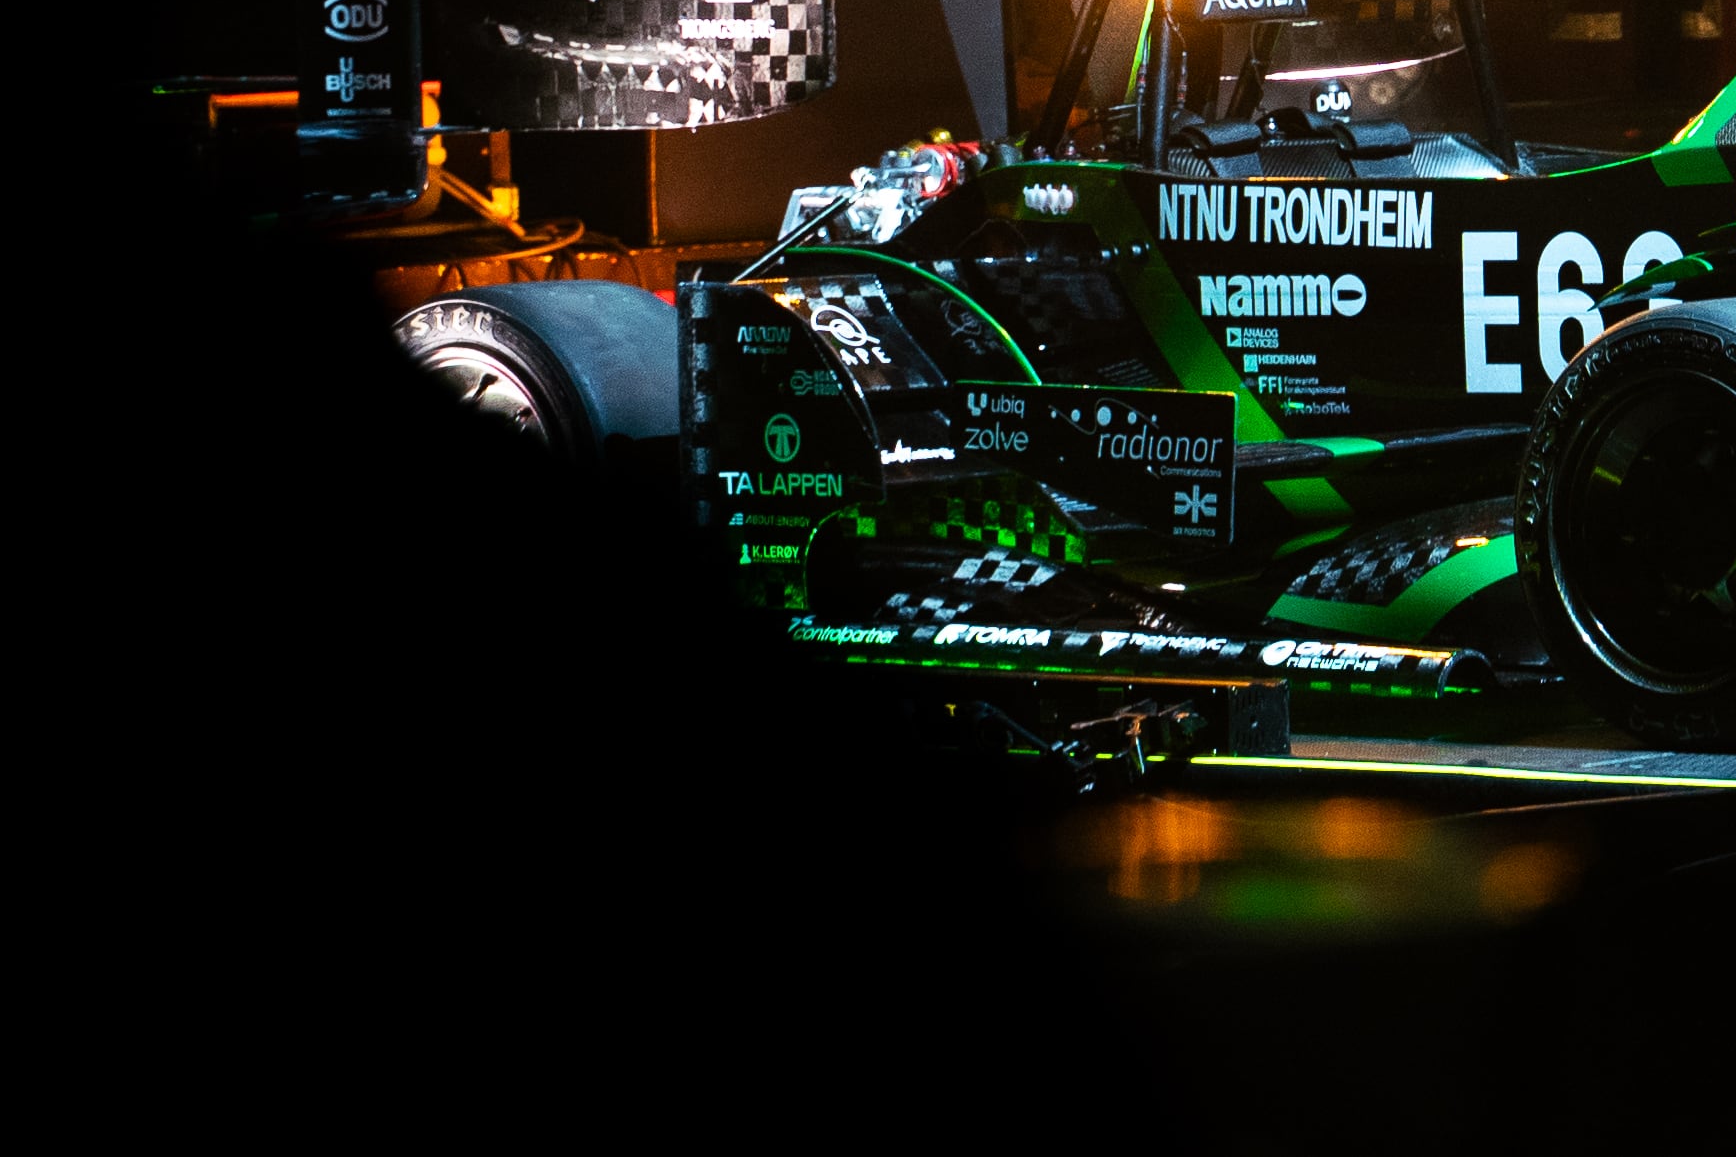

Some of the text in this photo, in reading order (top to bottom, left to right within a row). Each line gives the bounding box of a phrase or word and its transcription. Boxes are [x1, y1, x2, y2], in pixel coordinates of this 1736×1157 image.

[330, 4, 383, 29] ODU
[1159, 184, 1433, 249] NTNU TRONDHEIM
[1243, 327, 1279, 338] ANALOG
[1243, 338, 1279, 348] DEVICES
[1258, 354, 1316, 365] HEIDENHAIN
[1258, 375, 1283, 394] FFI
[991, 395, 1025, 418] ubiq
[964, 421, 1029, 452] zolve
[1097, 424, 1223, 464] radionor
[1160, 465, 1222, 478] Communications
[718, 472, 843, 497] TA LAPPEN
[793, 625, 898, 645] controlpartner
[966, 626, 1051, 646] TOMRA
